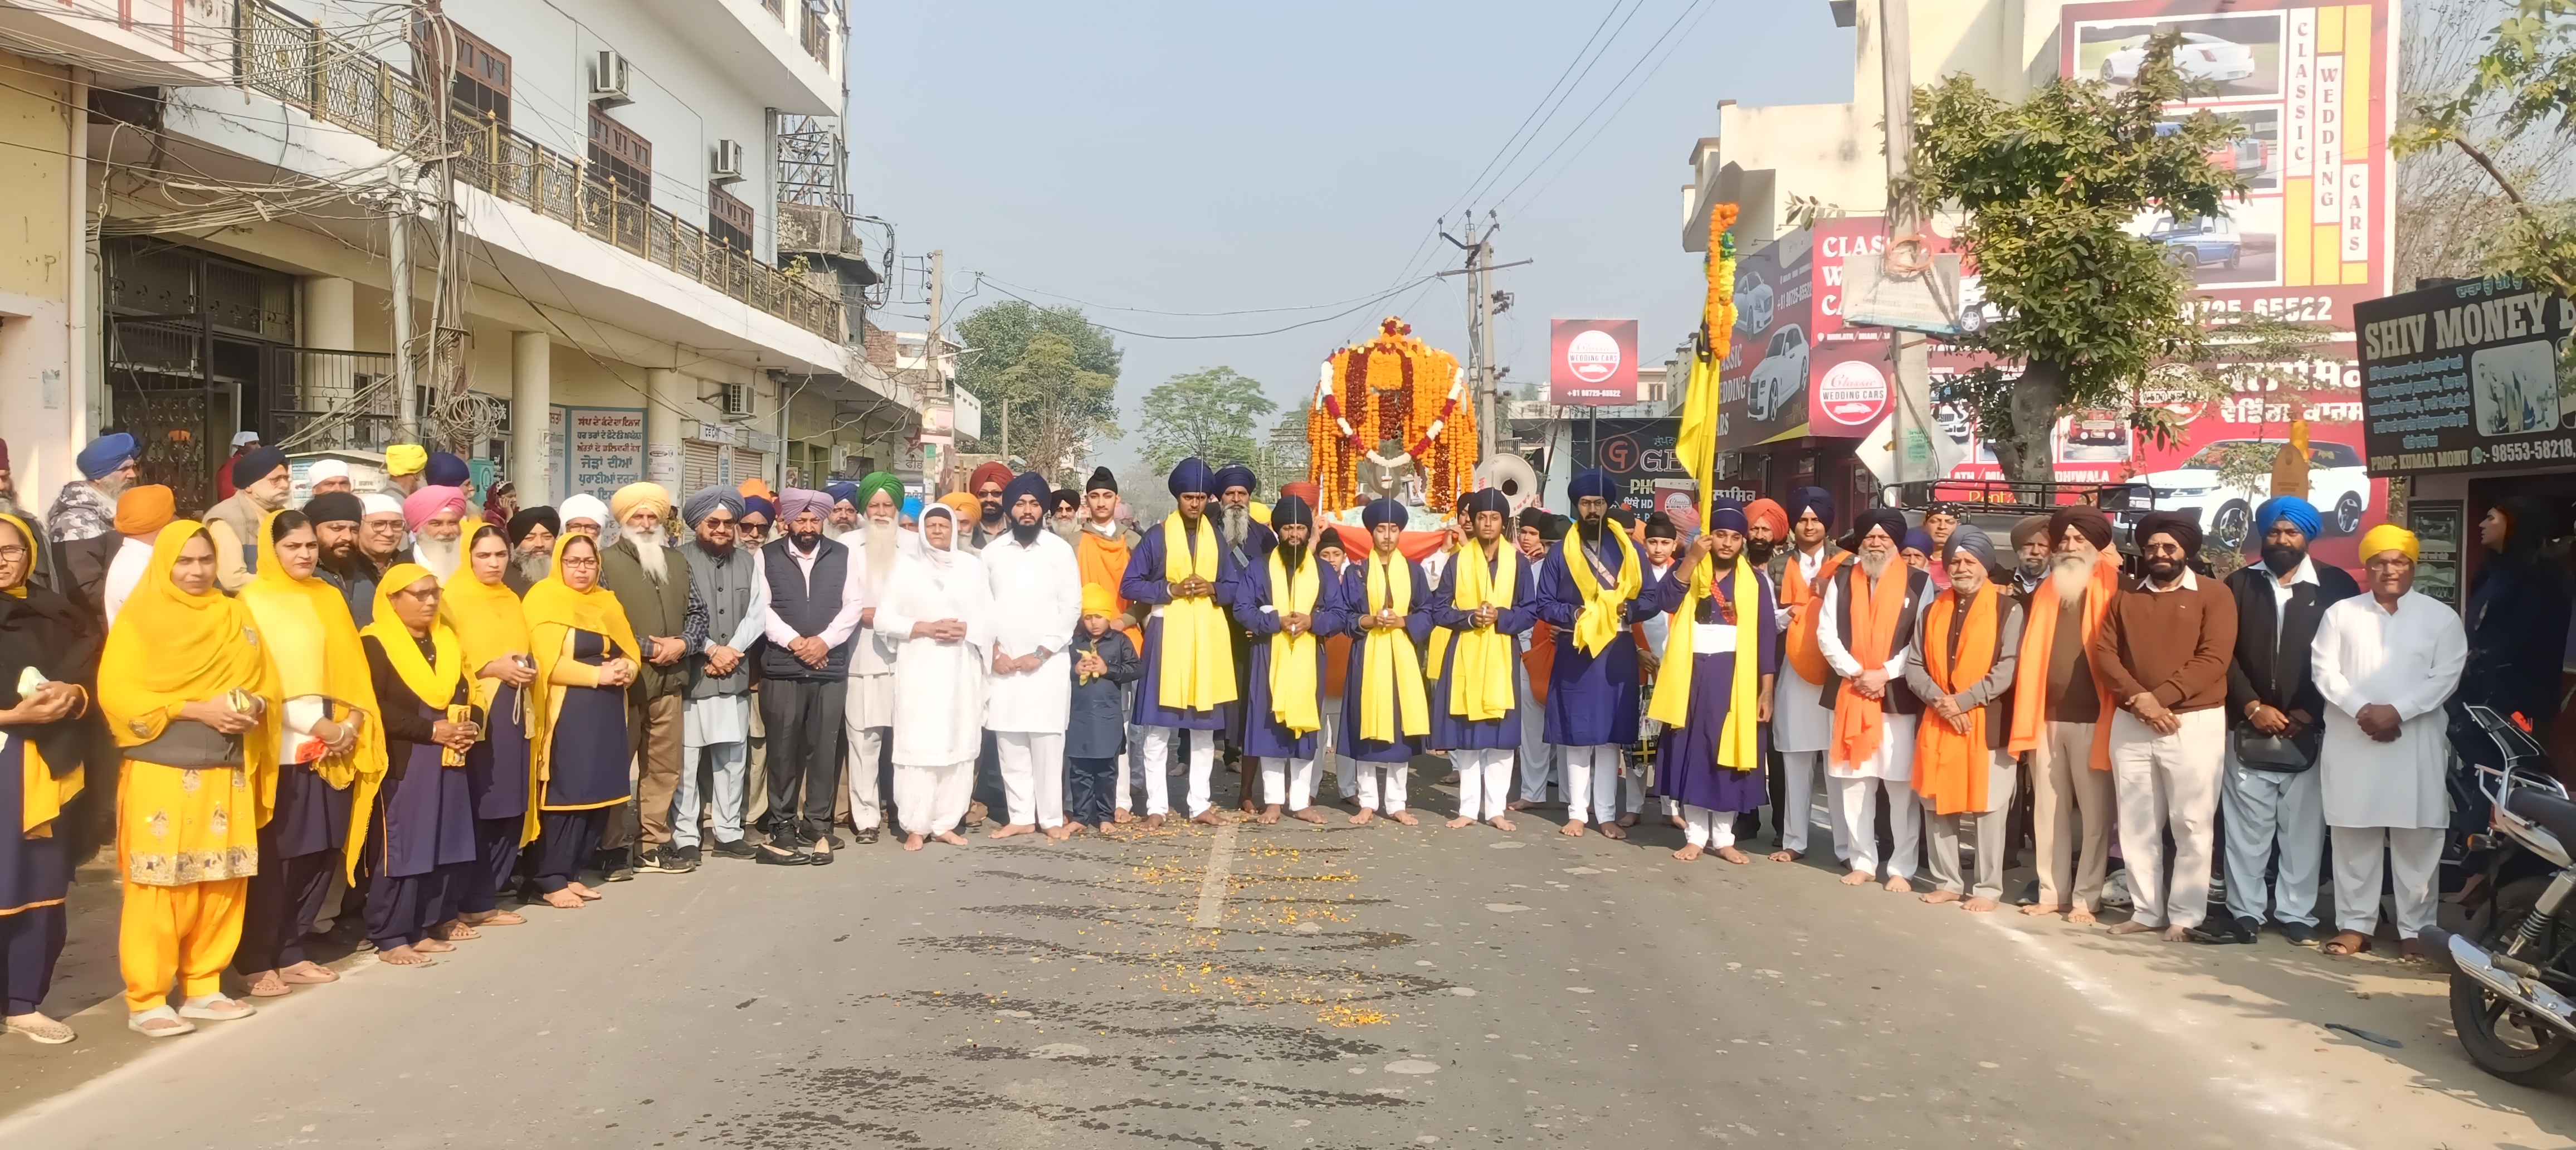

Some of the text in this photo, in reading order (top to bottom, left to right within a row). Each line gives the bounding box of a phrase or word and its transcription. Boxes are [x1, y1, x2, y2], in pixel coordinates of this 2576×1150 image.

[2294, 22, 2307, 162] CLASSIC
[2320, 68, 2338, 207] WEDDING
[2349, 173, 2363, 252] CARS
[2365, 314, 2427, 360] SHIV
[2433, 292, 2548, 350] MONEY
[1720, 343, 1742, 372] ASSIC
[1719, 375, 1746, 405] EDDING
[1831, 374, 1875, 387] Classic
[1823, 391, 1884, 399] WEDDING CARS
[1716, 412, 1729, 436] ARS
[607, 455, 632, 469] ਦੀਆਂ
[2371, 456, 2397, 471] PROP:
[2399, 453, 2436, 470] KUMAR
[2055, 470, 2110, 483] DHIWALA
[1641, 499, 1653, 509] HD
[1713, 486, 1756, 501] ਲਾਸਿਕ
